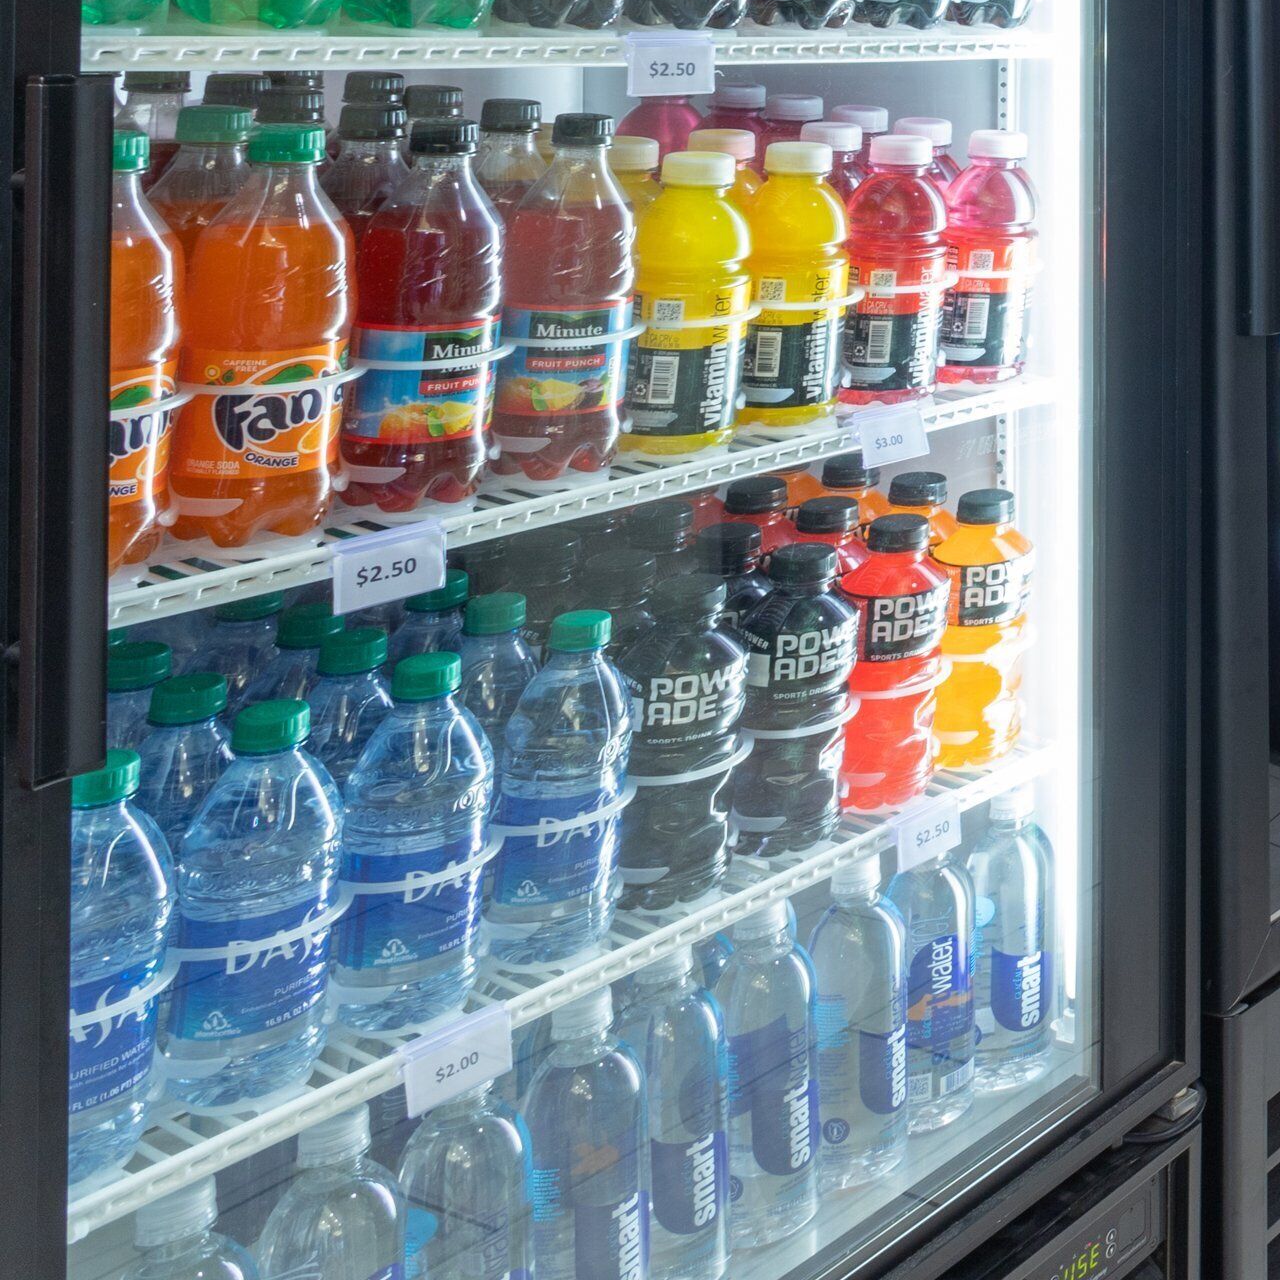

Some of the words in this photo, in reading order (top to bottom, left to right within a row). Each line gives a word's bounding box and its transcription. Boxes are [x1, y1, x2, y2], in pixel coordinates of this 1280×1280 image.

[649, 61, 696, 78] $2.50
[536, 322, 604, 340] Minute
[223, 358, 268, 368] CAFFEINE
[235, 366, 258, 374] FREE
[531, 358, 566, 370] FRUIT
[567, 357, 601, 369] PUNCH
[875, 434, 903, 450] $3.00
[244, 452, 299, 468] ORANGE
[356, 557, 417, 588] $2.50
[916, 821, 950, 847] $2.50
[121, 1036, 151, 1060] WATER
[435, 1051, 479, 1084] $2.00
